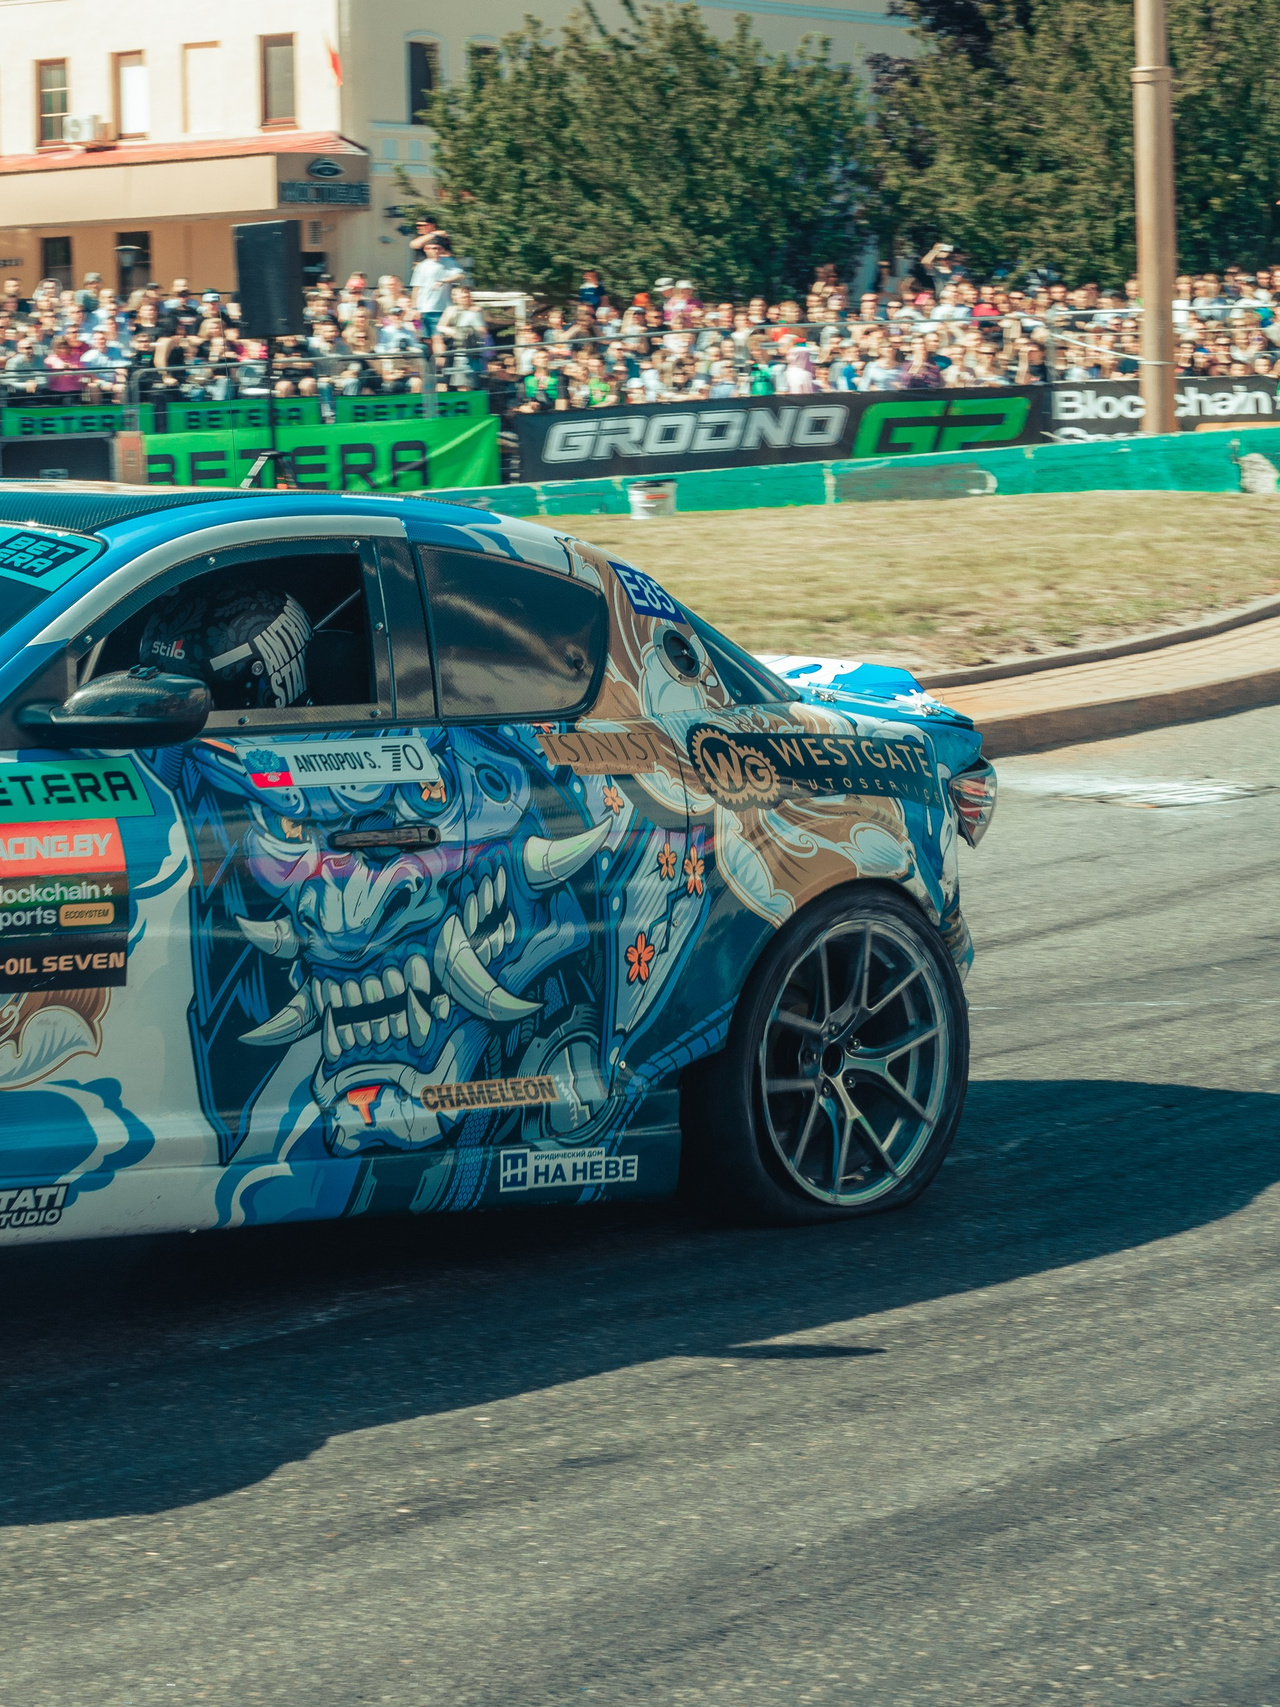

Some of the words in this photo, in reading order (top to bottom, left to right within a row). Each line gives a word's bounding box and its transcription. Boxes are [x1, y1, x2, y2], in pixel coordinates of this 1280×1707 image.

[542, 403, 850, 464] GRODNO
[851, 397, 1032, 459] GP
[5, 535, 76, 561] BET
[615, 568, 676, 614] E85
[293, 751, 364, 773] ANTROPOV
[369, 751, 381, 770] S.
[381, 743, 424, 772] 70
[537, 732, 661, 763] TSINIST
[767, 737, 933, 778] WESTGATE
[792, 777, 941, 804] AUTOSERVICE
[64, 908, 110, 920] ECOSYSTEM
[41, 951, 126, 974] SEVEN
[422, 1077, 558, 1110] CHAMELEON
[533, 1150, 586, 1162] ЮРИДИЧЕСКИЙ
[587, 1149, 604, 1159] ДОМ
[533, 1163, 567, 1186] НА
[571, 1158, 636, 1182] НЕВЕ
